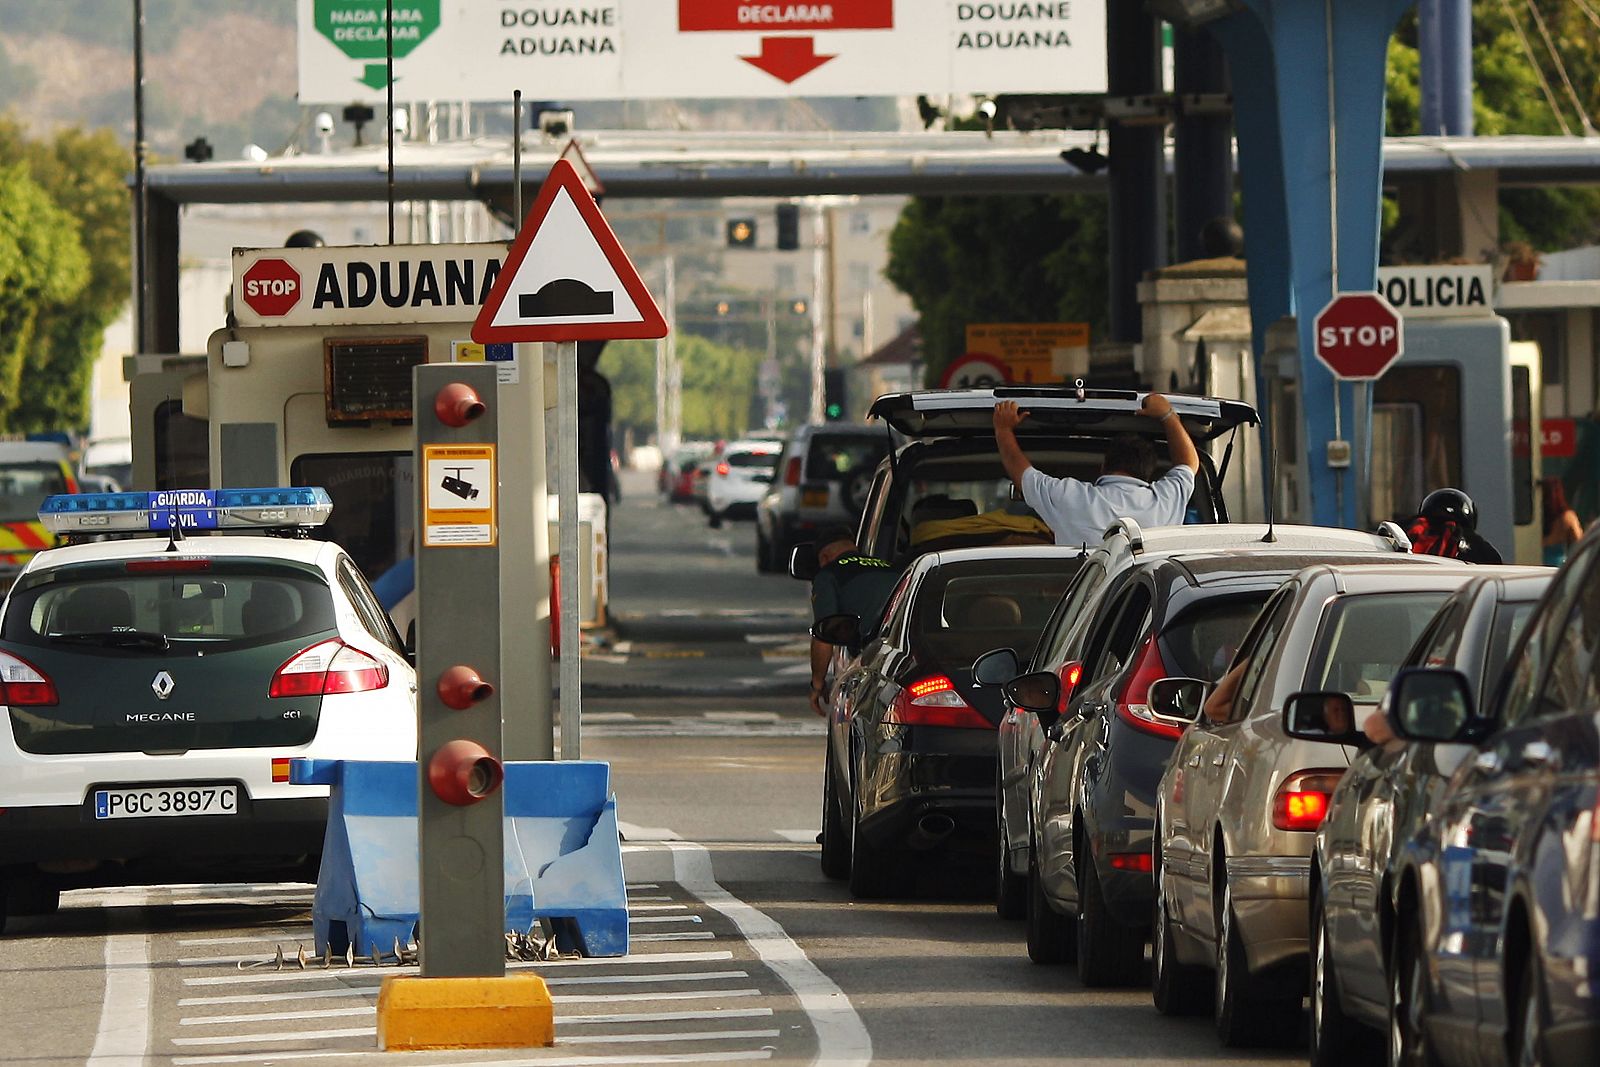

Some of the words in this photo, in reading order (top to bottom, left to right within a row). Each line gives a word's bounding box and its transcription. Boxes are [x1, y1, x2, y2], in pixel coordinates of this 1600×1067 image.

[331, 9, 377, 24] NADA
[501, 8, 614, 27] DOUANE
[737, 5, 833, 23] DECLARAR
[957, 2, 1072, 21] DOUANE
[335, 26, 420, 41] DECLARAR
[957, 31, 1072, 48] ADUANA
[500, 37, 615, 55] ADUANA
[247, 279, 297, 297] STOP
[1321, 325, 1395, 348] STOP
[157, 492, 206, 506] GUARDIA
[168, 514, 198, 528] CVIL
[126, 712, 195, 722] MEGANE
[109, 792, 153, 815] PGC
[158, 790, 216, 812] 3897
[220, 789, 234, 810] C
